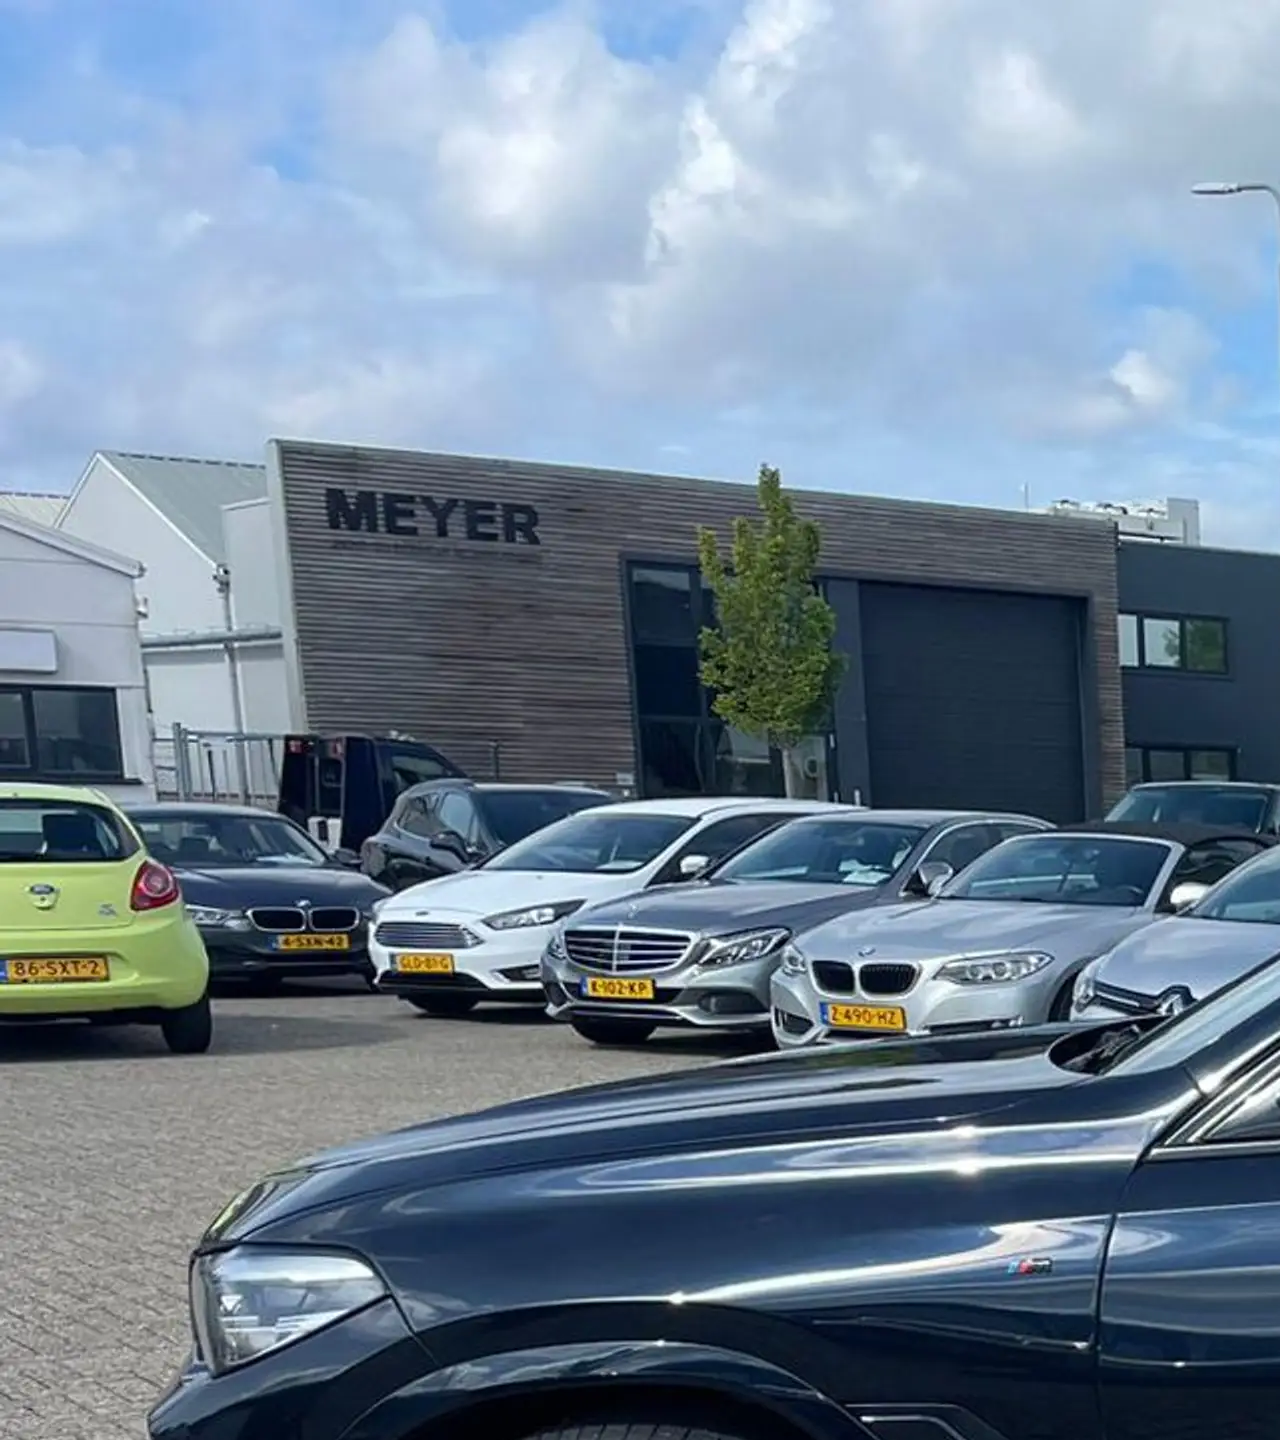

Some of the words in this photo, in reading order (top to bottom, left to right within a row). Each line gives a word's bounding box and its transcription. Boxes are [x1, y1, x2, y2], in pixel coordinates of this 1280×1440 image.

[325, 488, 541, 545] MEYER
[13, 960, 100, 977] 86-SXT-2
[830, 1005, 897, 1025] Z-490-HZ
